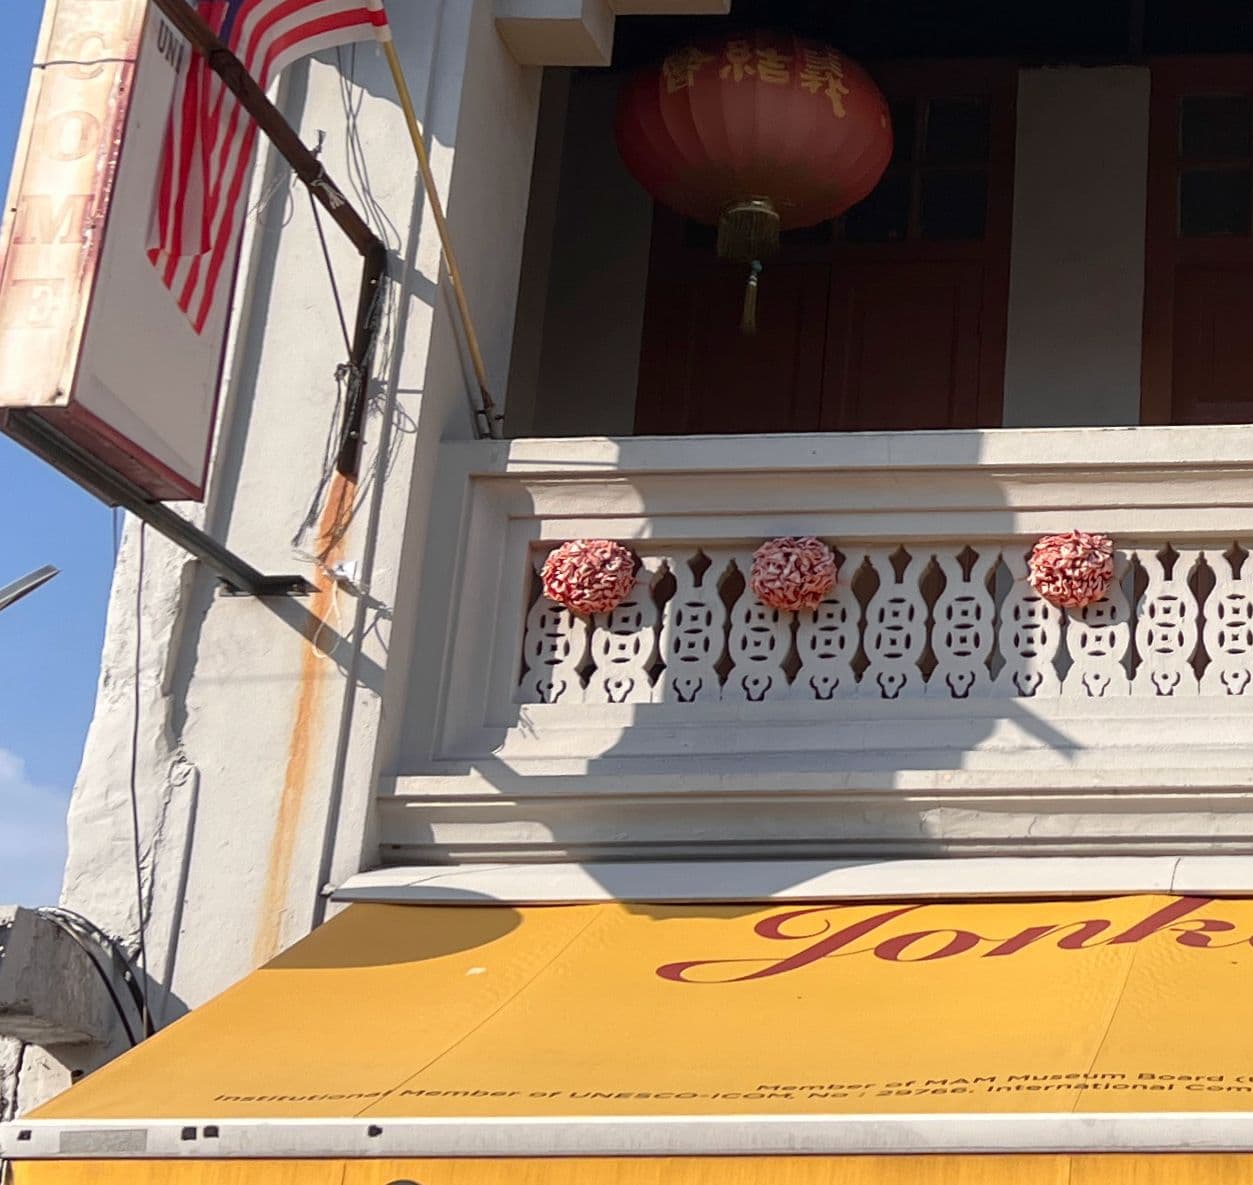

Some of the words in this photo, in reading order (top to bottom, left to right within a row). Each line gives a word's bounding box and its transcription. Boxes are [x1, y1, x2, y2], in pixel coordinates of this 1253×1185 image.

[213, 1089, 396, 1102] Institutional
[400, 1089, 521, 1097] Member
[987, 1082, 1175, 1092] International
[756, 1083, 877, 1092] Member
[885, 1080, 916, 1089] of
[925, 1076, 996, 1086] MAM
[1007, 1072, 1127, 1082] Museum
[1137, 1072, 1225, 1082] Board
